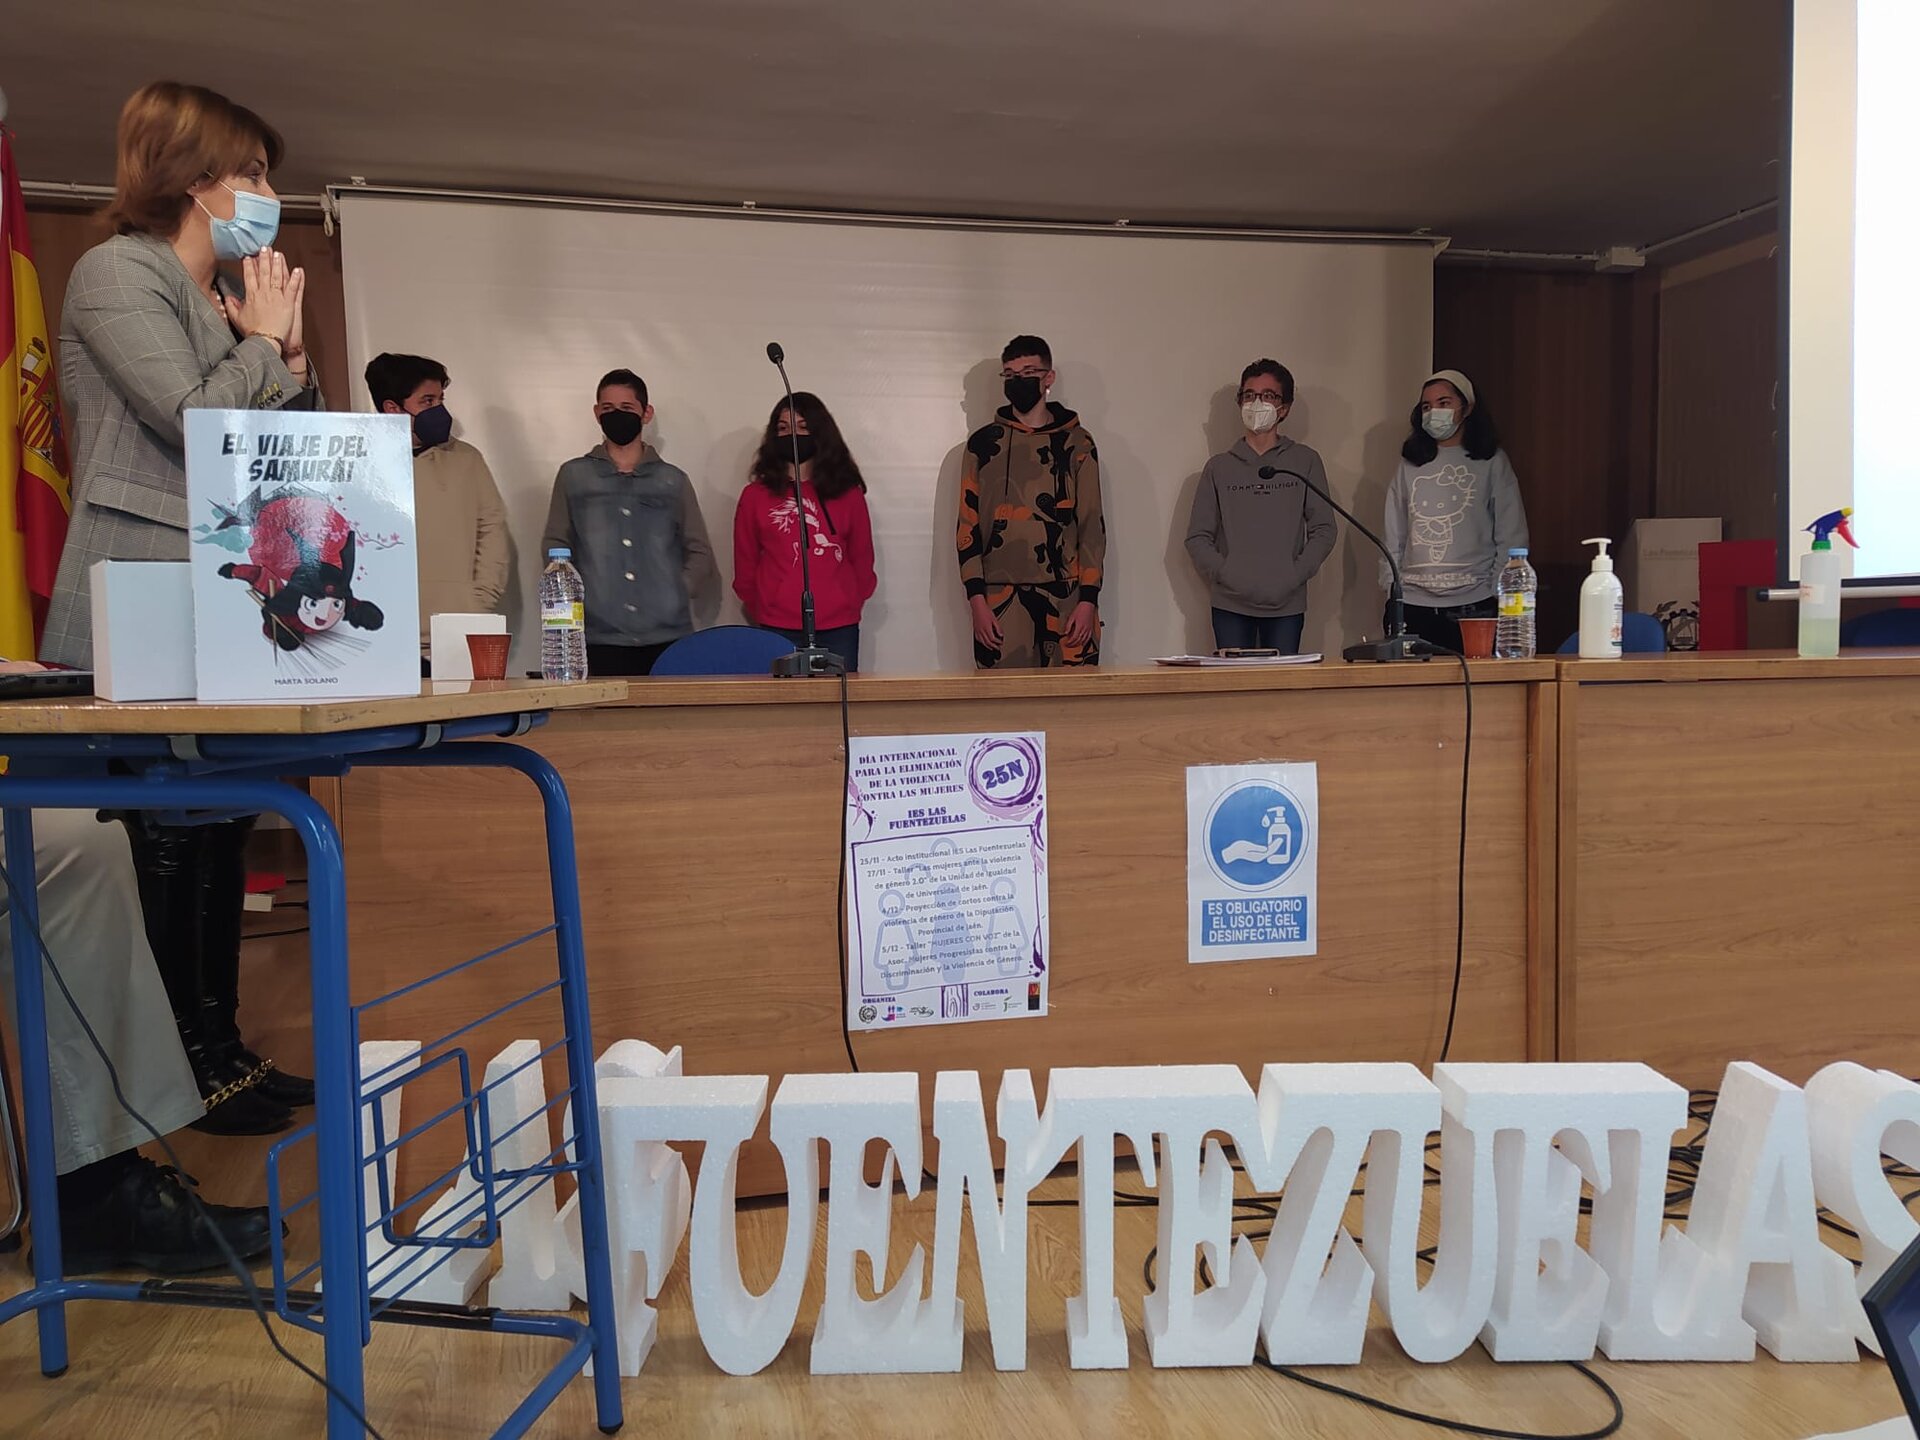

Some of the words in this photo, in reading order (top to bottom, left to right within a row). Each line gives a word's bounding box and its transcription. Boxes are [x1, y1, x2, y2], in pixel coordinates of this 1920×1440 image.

[222, 433, 247, 455] EL
[258, 434, 321, 457] VIAJE
[327, 435, 368, 458] DEL
[859, 753, 876, 764] DÍA
[880, 748, 957, 763] INTERNACIONAL
[855, 767, 880, 777] PARA
[885, 766, 896, 774] LA
[899, 758, 962, 773] ELIMINACIÓN
[982, 759, 1025, 789] 25N
[869, 780, 882, 788] DE
[885, 778, 896, 787] LA
[900, 774, 950, 785] VIOLENCIA
[857, 791, 895, 802] CONTRA
[899, 788, 916, 798] LAS
[920, 784, 964, 795] MUJERES
[908, 809, 924, 818] IES
[929, 807, 946, 816] LAS
[889, 814, 966, 830] FUENTEZUELAS
[860, 857, 879, 865] 25/11
[887, 854, 903, 862] Acto
[905, 849, 950, 860] institucional
[893, 867, 914, 876] Taller
[933, 861, 962, 872] mujeres
[964, 858, 979, 866] ante
[990, 854, 1021, 864] violencia
[874, 882, 883, 890] de
[929, 875, 938, 883] de
[940, 874, 946, 882] la
[948, 871, 973, 881] Unidad
[976, 869, 984, 877] de
[906, 891, 914, 899] de
[916, 886, 960, 898] Universidad
[906, 902, 946, 914] Proyección
[948, 899, 957, 907] de
[959, 897, 981, 906] cortos
[983, 895, 1006, 903] contra
[1208, 902, 1223, 916] ES
[1225, 900, 1302, 914] OBLIGATORIO
[884, 917, 916, 927] violencia
[919, 915, 928, 923] de
[966, 909, 973, 917] la
[1212, 916, 1227, 929] EL
[1230, 916, 1254, 929] USO
[1257, 915, 1272, 928] DE
[1275, 913, 1297, 926] GEL
[918, 925, 954, 936] Provincial
[955, 924, 964, 932] de
[1209, 927, 1300, 943] DESINFECTANTE
[906, 943, 926, 951] Taller
[939, 948, 983, 961] Progresistas
[985, 945, 1008, 954] contra
[880, 967, 935, 979] Discriminación
[943, 963, 950, 971] la
[952, 959, 985, 970] Violencia
